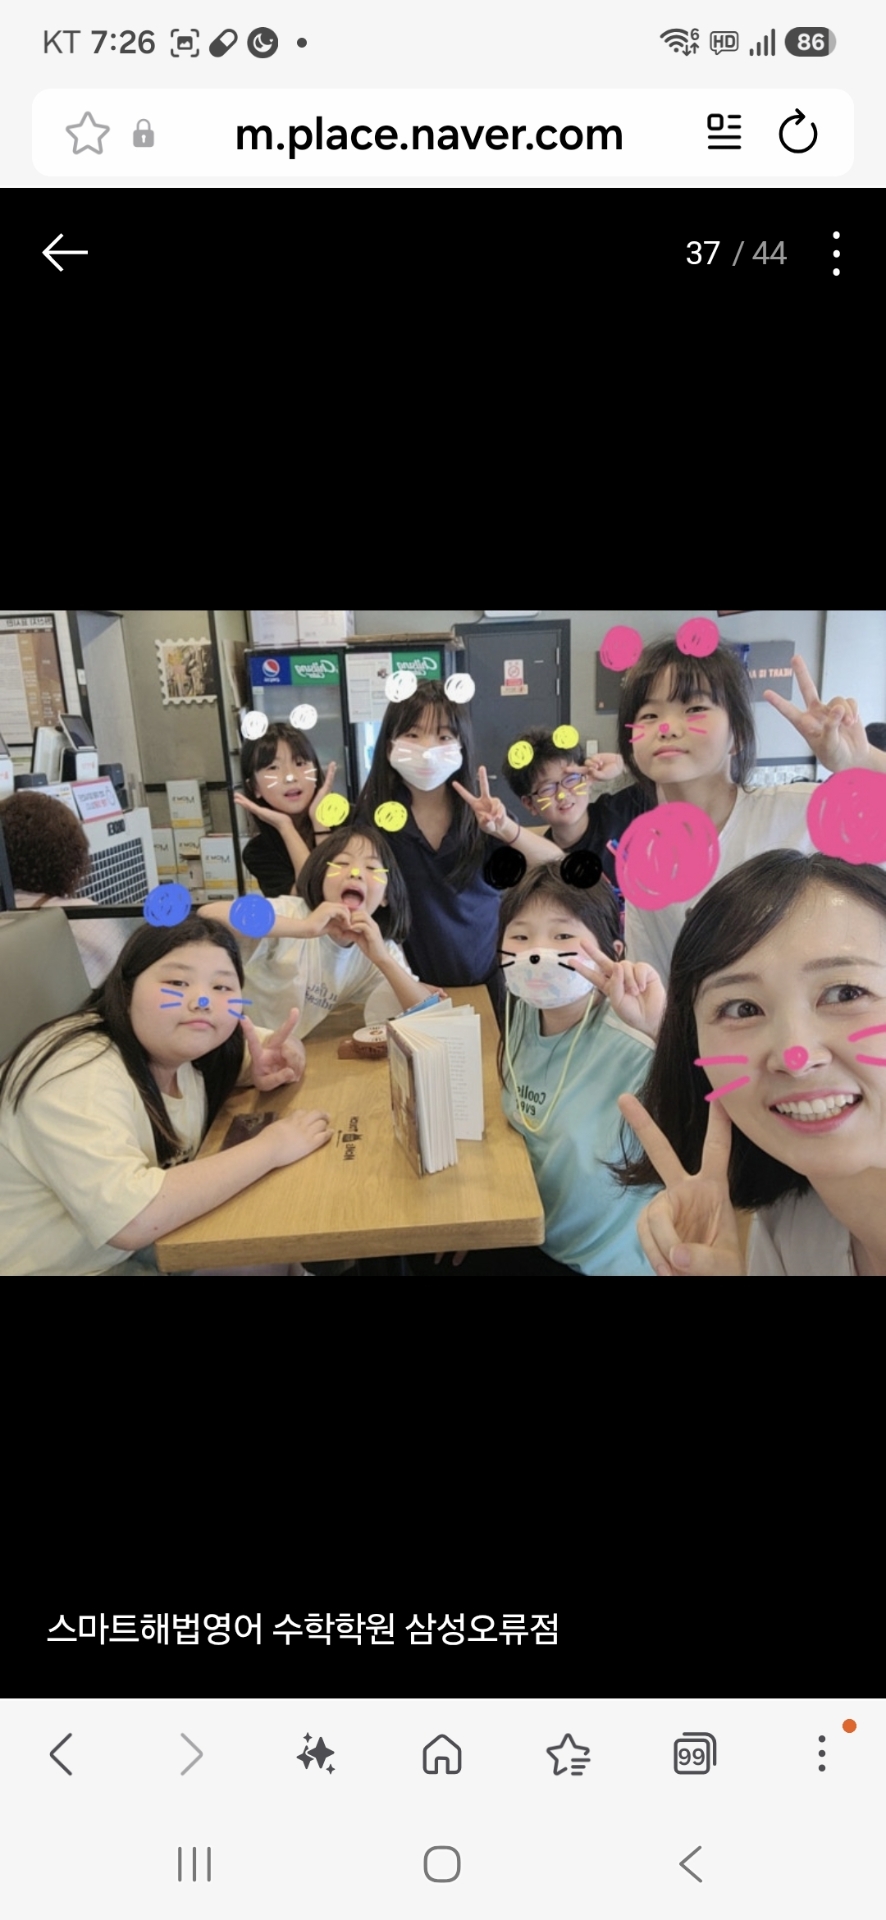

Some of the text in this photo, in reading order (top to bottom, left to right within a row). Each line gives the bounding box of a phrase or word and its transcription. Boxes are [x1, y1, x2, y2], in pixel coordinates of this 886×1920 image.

[44, 30, 156, 55] KT 7:26
[713, 34, 736, 49] HD
[797, 32, 825, 52] 86
[236, 115, 623, 160] m.place.naver.com
[686, 241, 720, 265] 37
[752, 241, 787, 265] 44
[679, 1747, 706, 1766] 99
